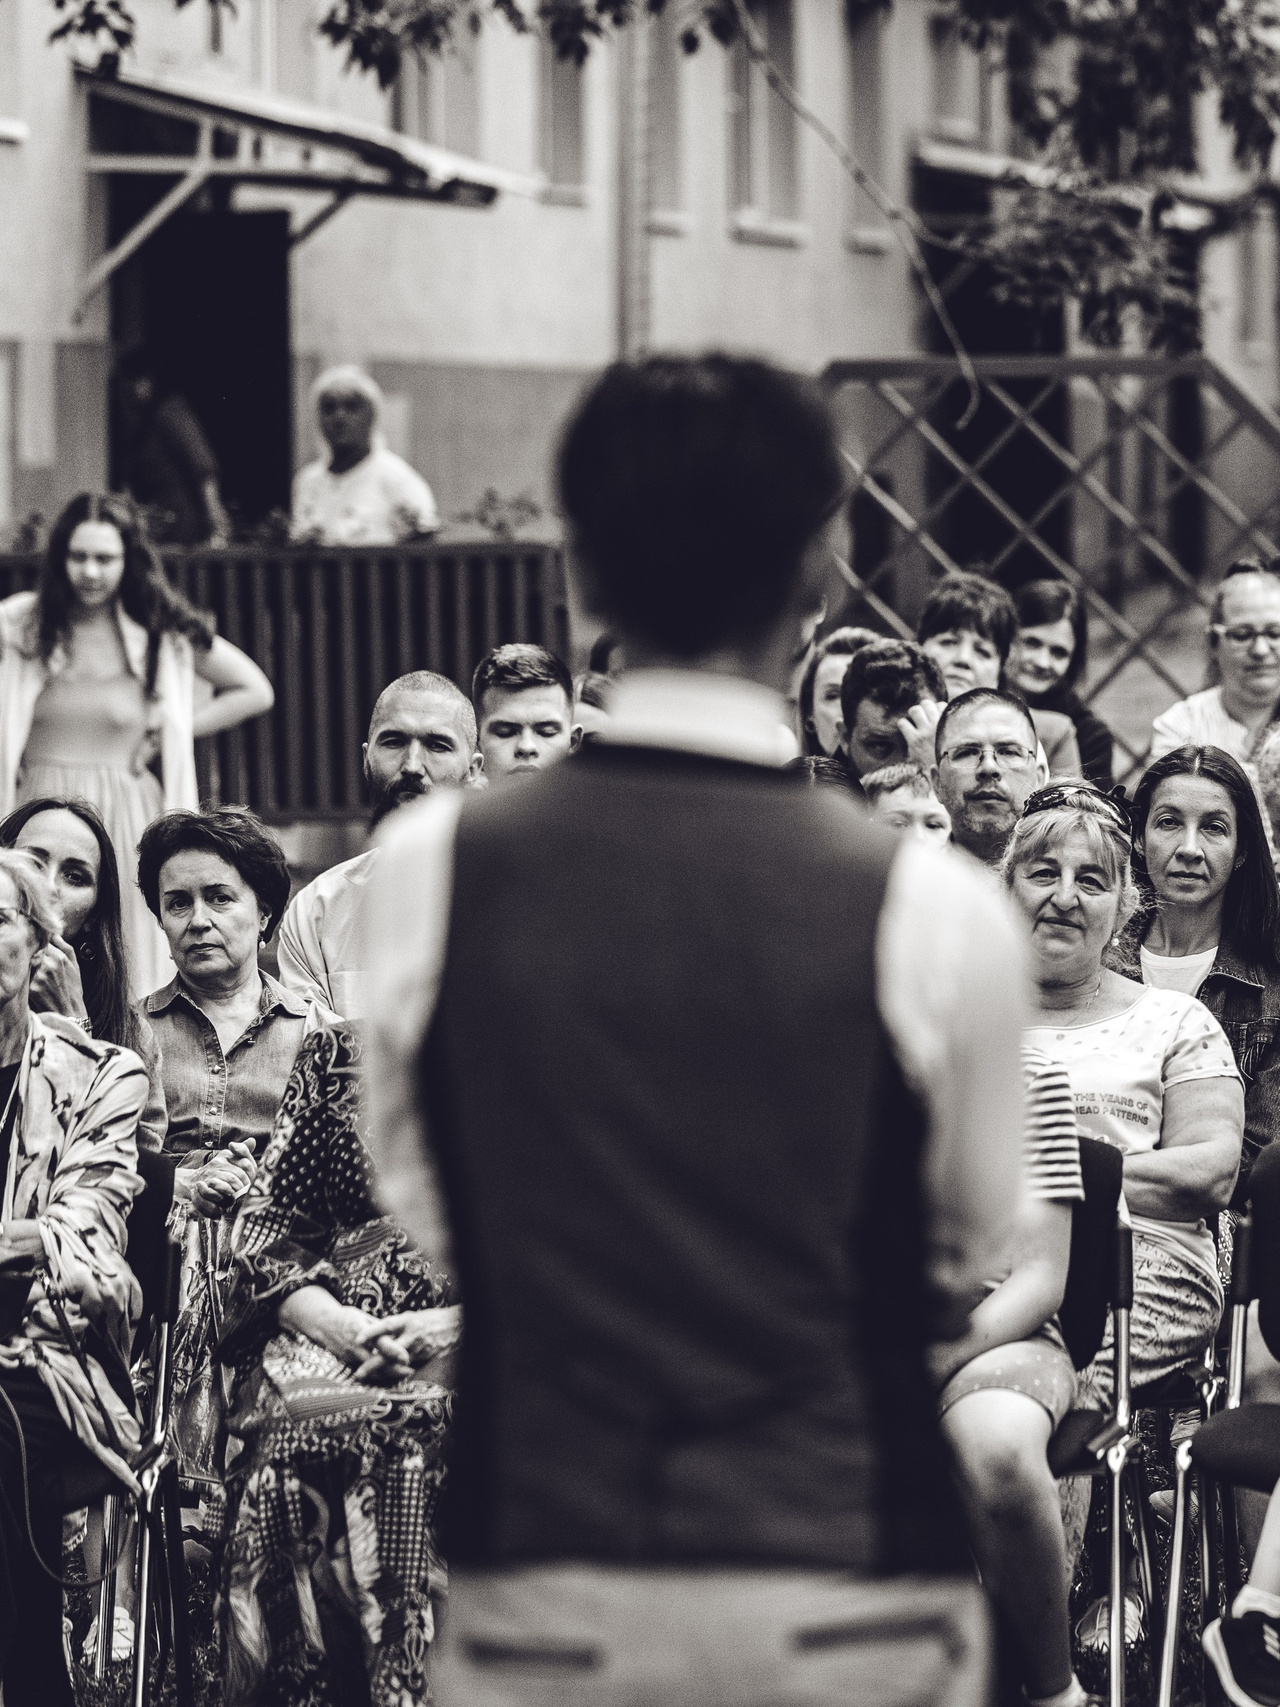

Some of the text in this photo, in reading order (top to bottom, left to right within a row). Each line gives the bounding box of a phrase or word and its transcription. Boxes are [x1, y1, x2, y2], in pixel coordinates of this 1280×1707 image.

[1074, 1092, 1148, 1111] THE YEARS OF
[1103, 1106, 1149, 1125] PATTERNS
